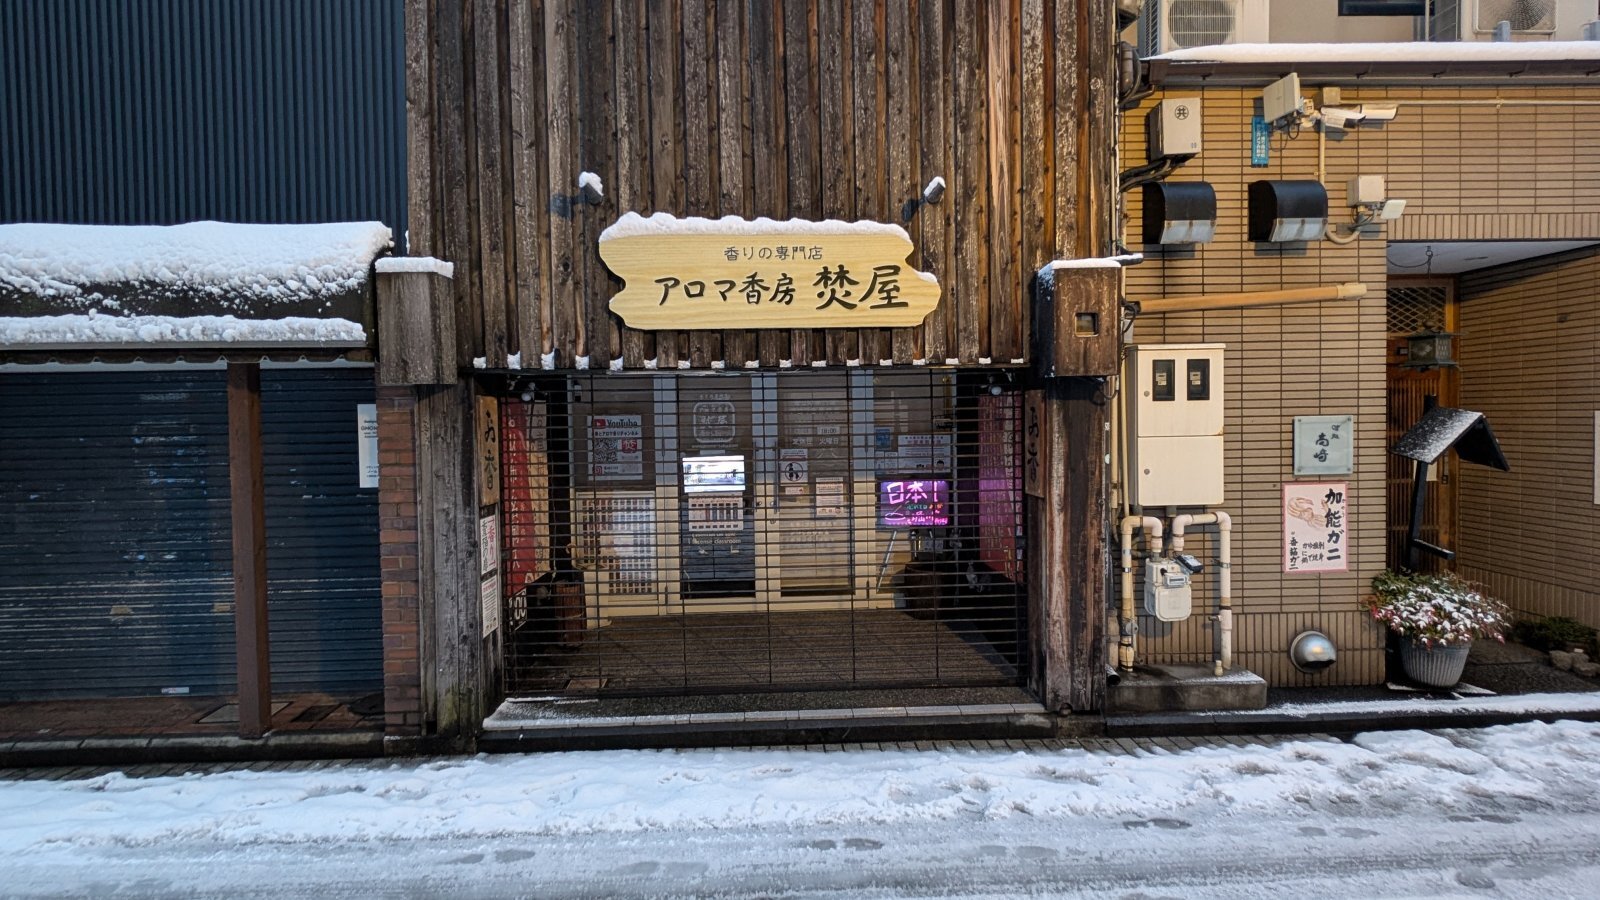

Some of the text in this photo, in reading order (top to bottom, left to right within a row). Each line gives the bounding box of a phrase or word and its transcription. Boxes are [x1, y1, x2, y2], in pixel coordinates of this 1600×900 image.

[724, 246, 823, 262] 香りの専門店
[654, 264, 908, 311] アロマ香房 焚屋
[484, 409, 497, 490] お香
[607, 418, 638, 428] YouTube
[1027, 406, 1039, 483] お香
[1325, 488, 1345, 561] 加能ガニ
